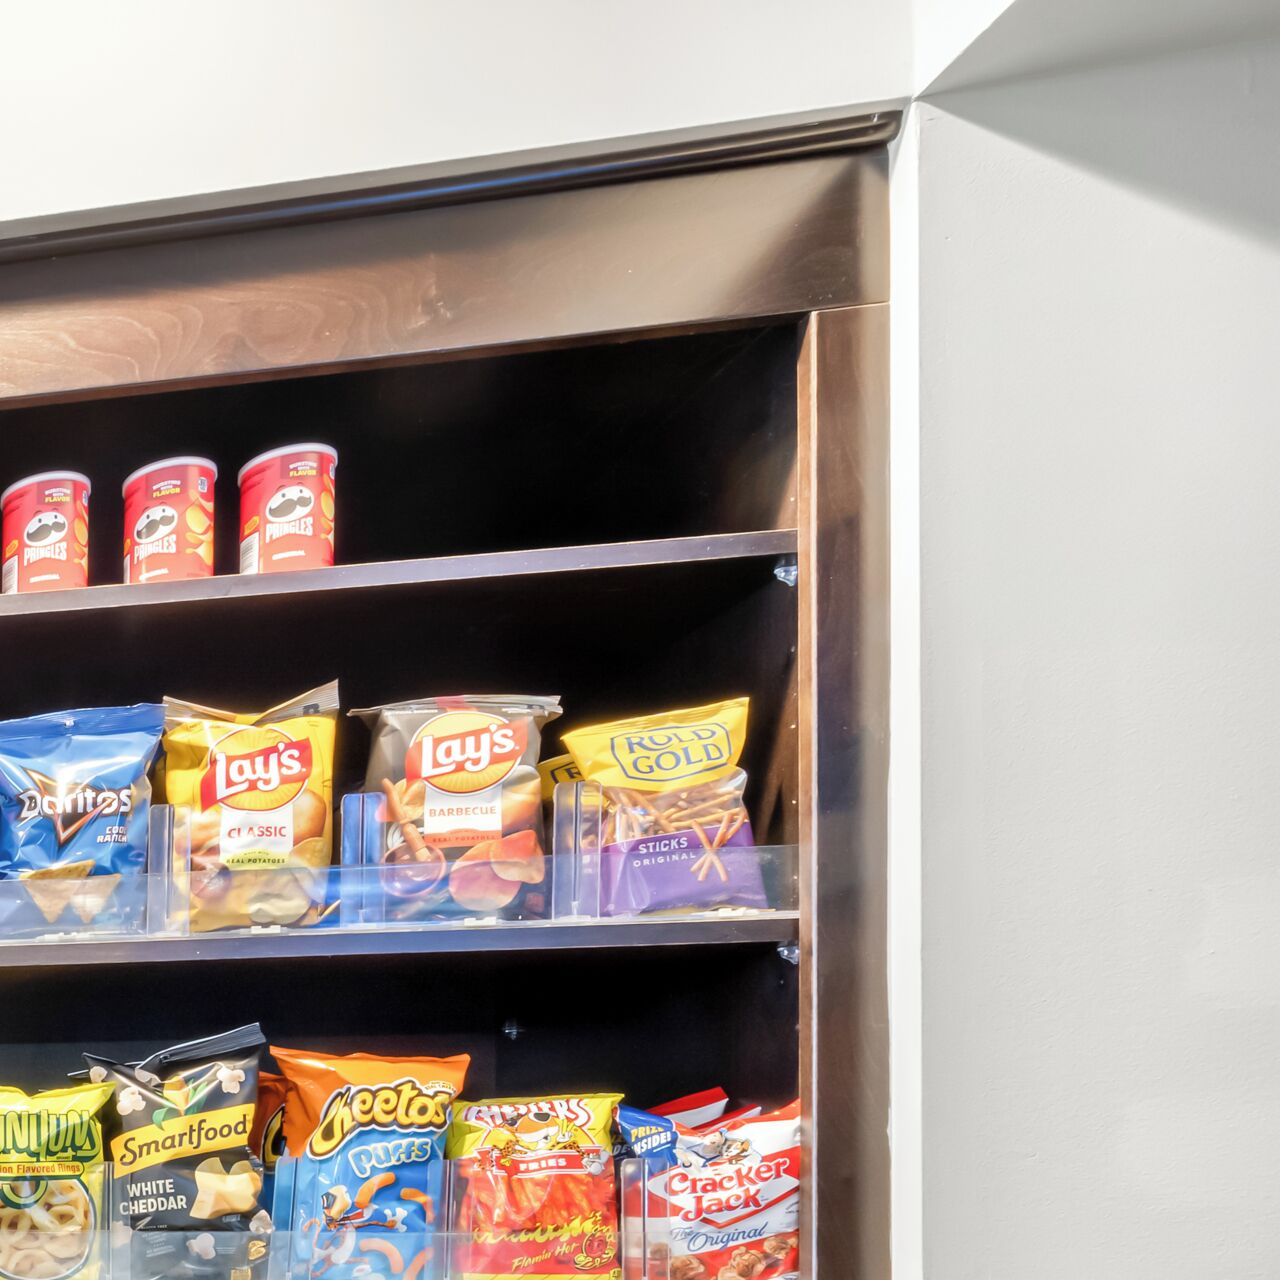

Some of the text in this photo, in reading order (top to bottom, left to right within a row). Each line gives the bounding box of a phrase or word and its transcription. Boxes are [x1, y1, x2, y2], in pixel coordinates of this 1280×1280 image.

[266, 517, 313, 543] PRINGLES
[24, 542, 67, 566] PRINGLES
[134, 535, 176, 564] PRINGLES
[421, 723, 516, 778] Lay's
[624, 728, 717, 754] ROLD
[631, 742, 724, 775] GOLD
[216, 742, 303, 802] Lay's
[18, 789, 132, 820] Doritos
[428, 805, 497, 818] BARBECUE
[638, 837, 689, 855] STICKS
[633, 853, 696, 868] ORIGINAL
[311, 1081, 450, 1157] Cheetos
[119, 1113, 249, 1167] Smartfood
[16, 1164, 56, 1174] Flavored
[520, 1158, 567, 1171] FRIES
[127, 1178, 175, 1198] WHITE
[665, 1159, 789, 1197] Cracker
[119, 1195, 188, 1215] CHEDDAR
[681, 1187, 762, 1222] Jack
[554, 1242, 580, 1256] Hot
[687, 1221, 769, 1252] Original
